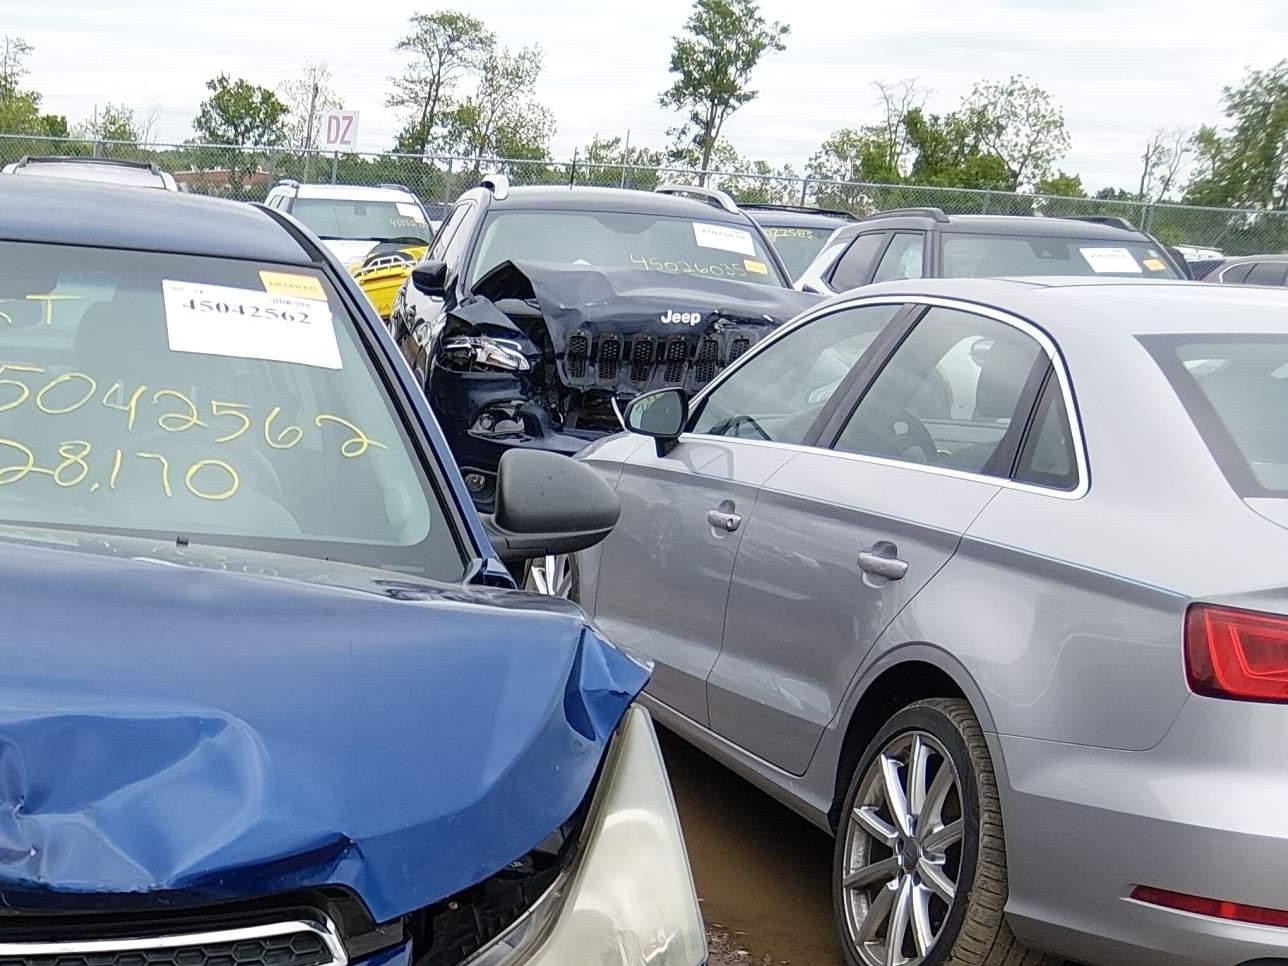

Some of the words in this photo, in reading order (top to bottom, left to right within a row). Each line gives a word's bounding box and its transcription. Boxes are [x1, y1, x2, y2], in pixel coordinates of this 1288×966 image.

[327, 115, 354, 145] DZ
[182, 299, 312, 325] 45042562
[660, 309, 701, 326] Jeep
